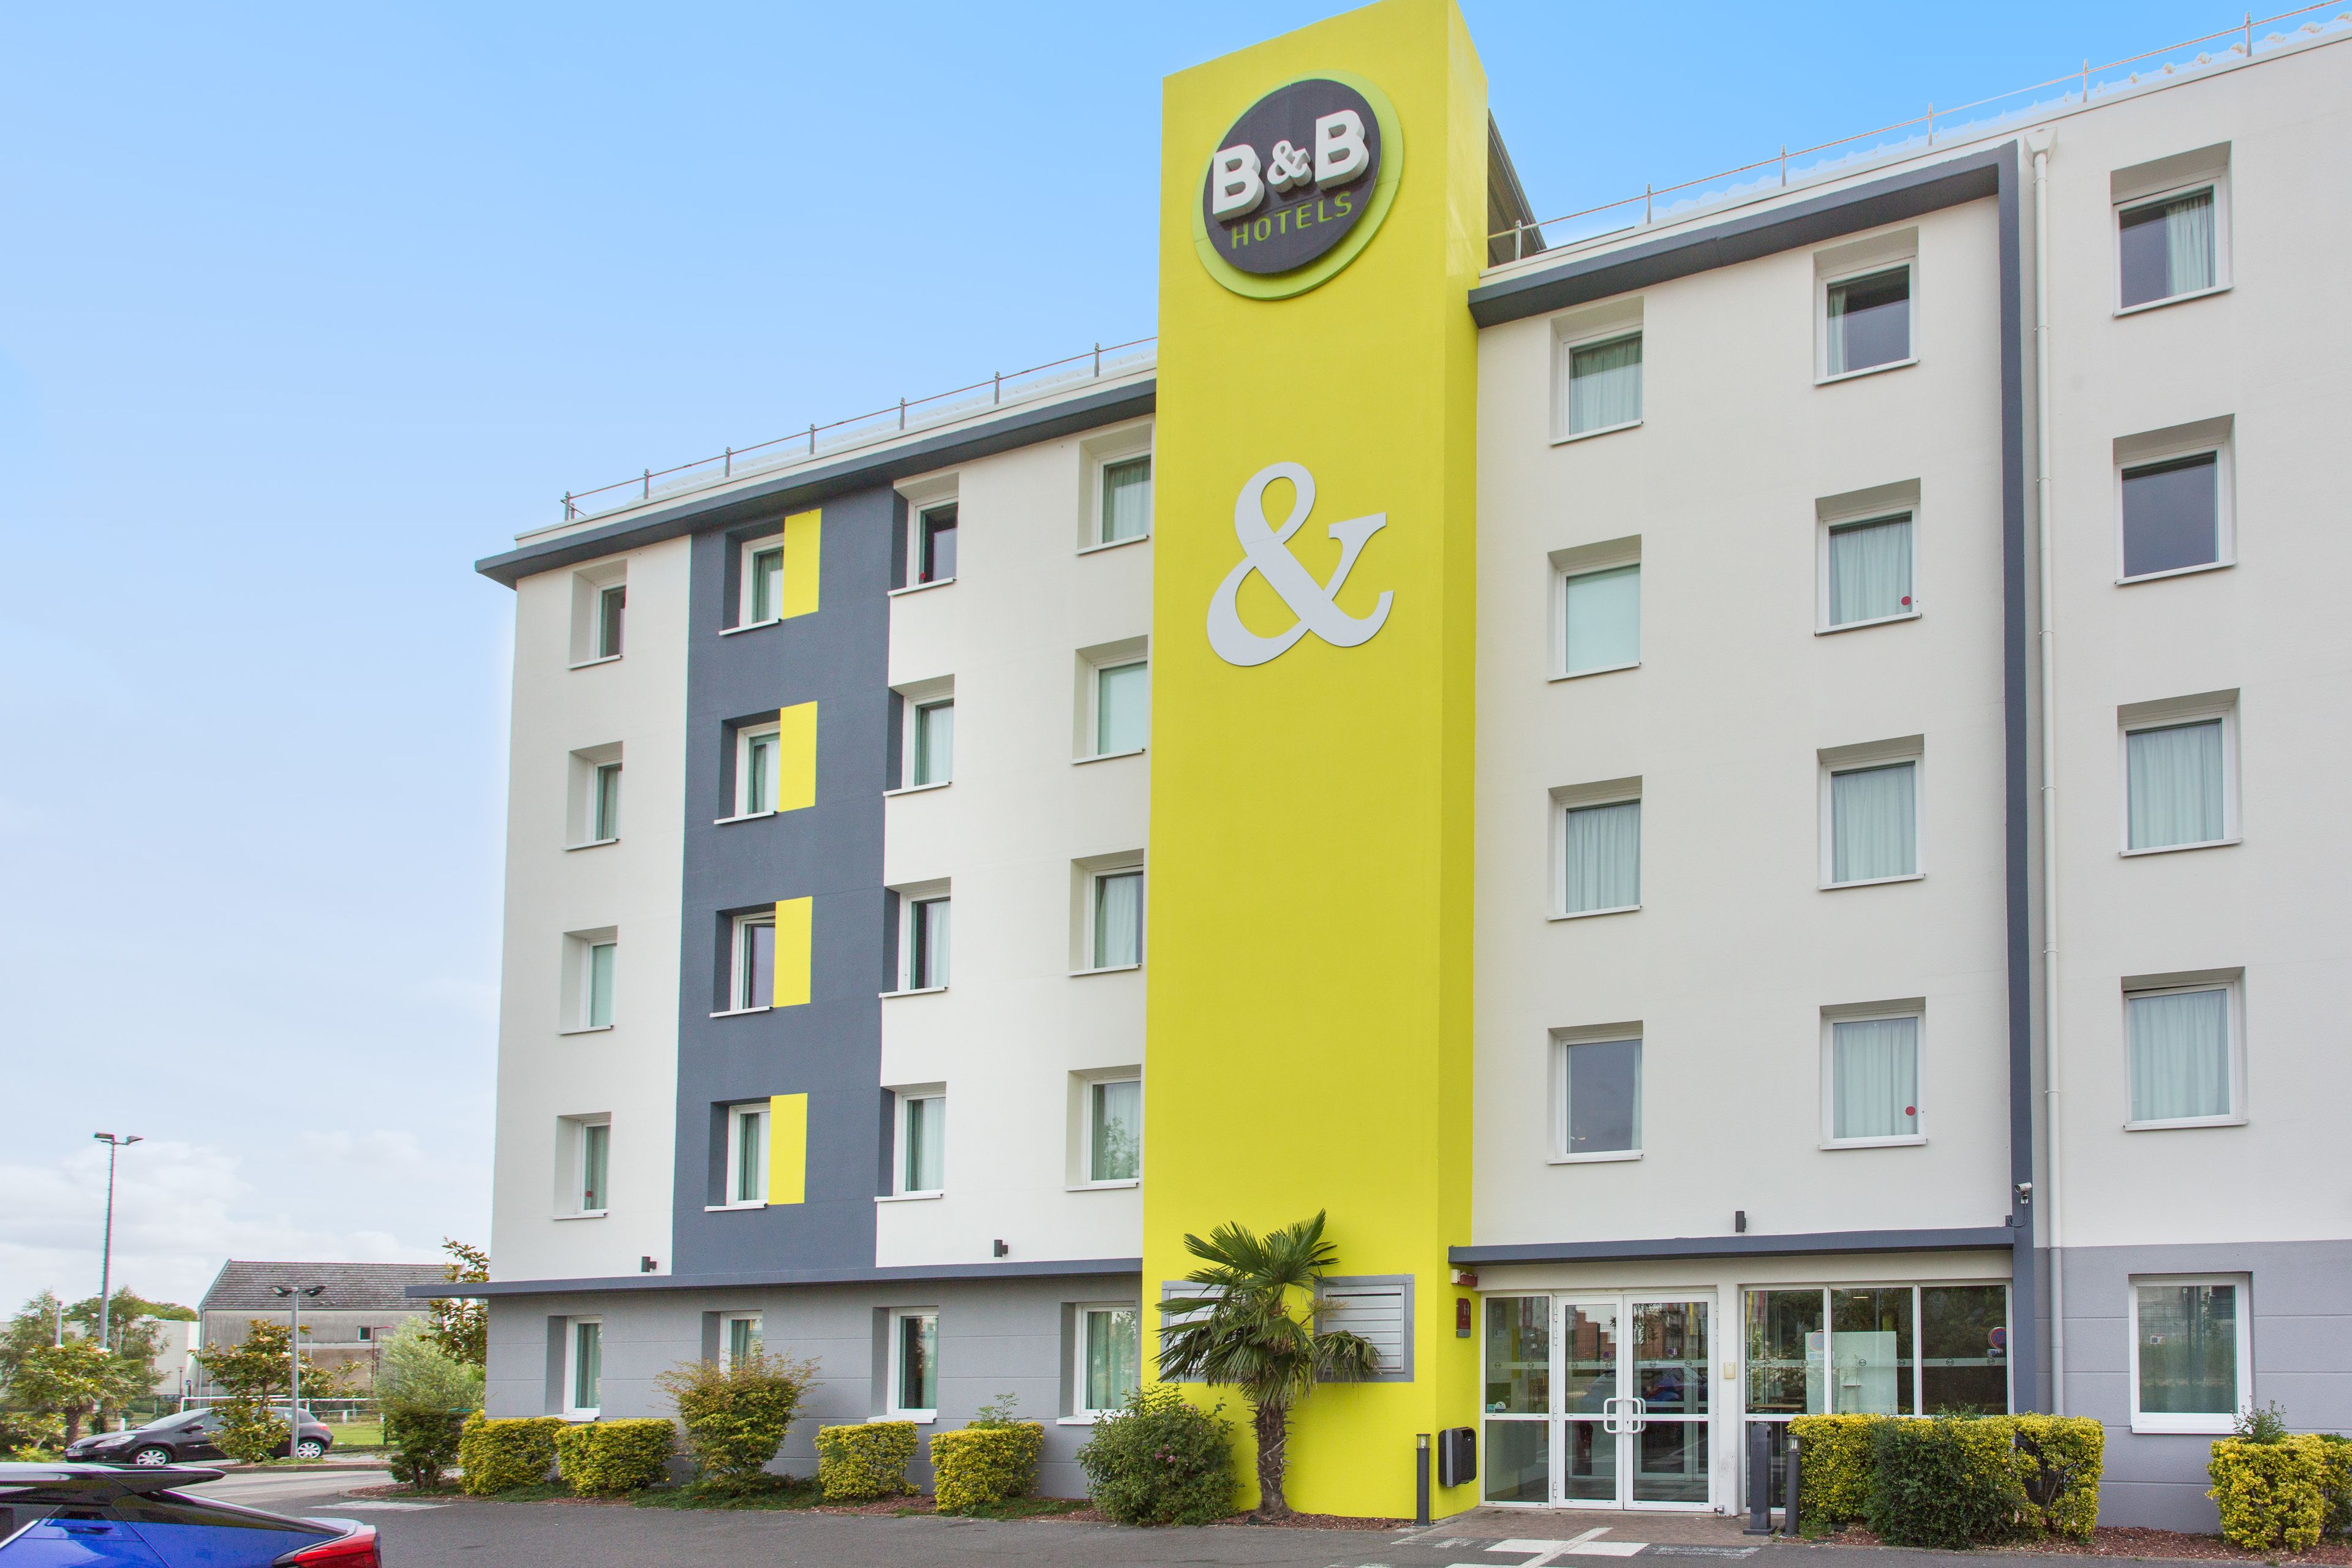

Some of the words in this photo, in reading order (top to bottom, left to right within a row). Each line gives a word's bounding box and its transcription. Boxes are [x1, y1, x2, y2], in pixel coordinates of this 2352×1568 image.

[1212, 109, 1370, 222] B&B
[1231, 191, 1352, 249] HOTELS
[1207, 461, 1394, 667] &
[1464, 1304, 1469, 1316] H
